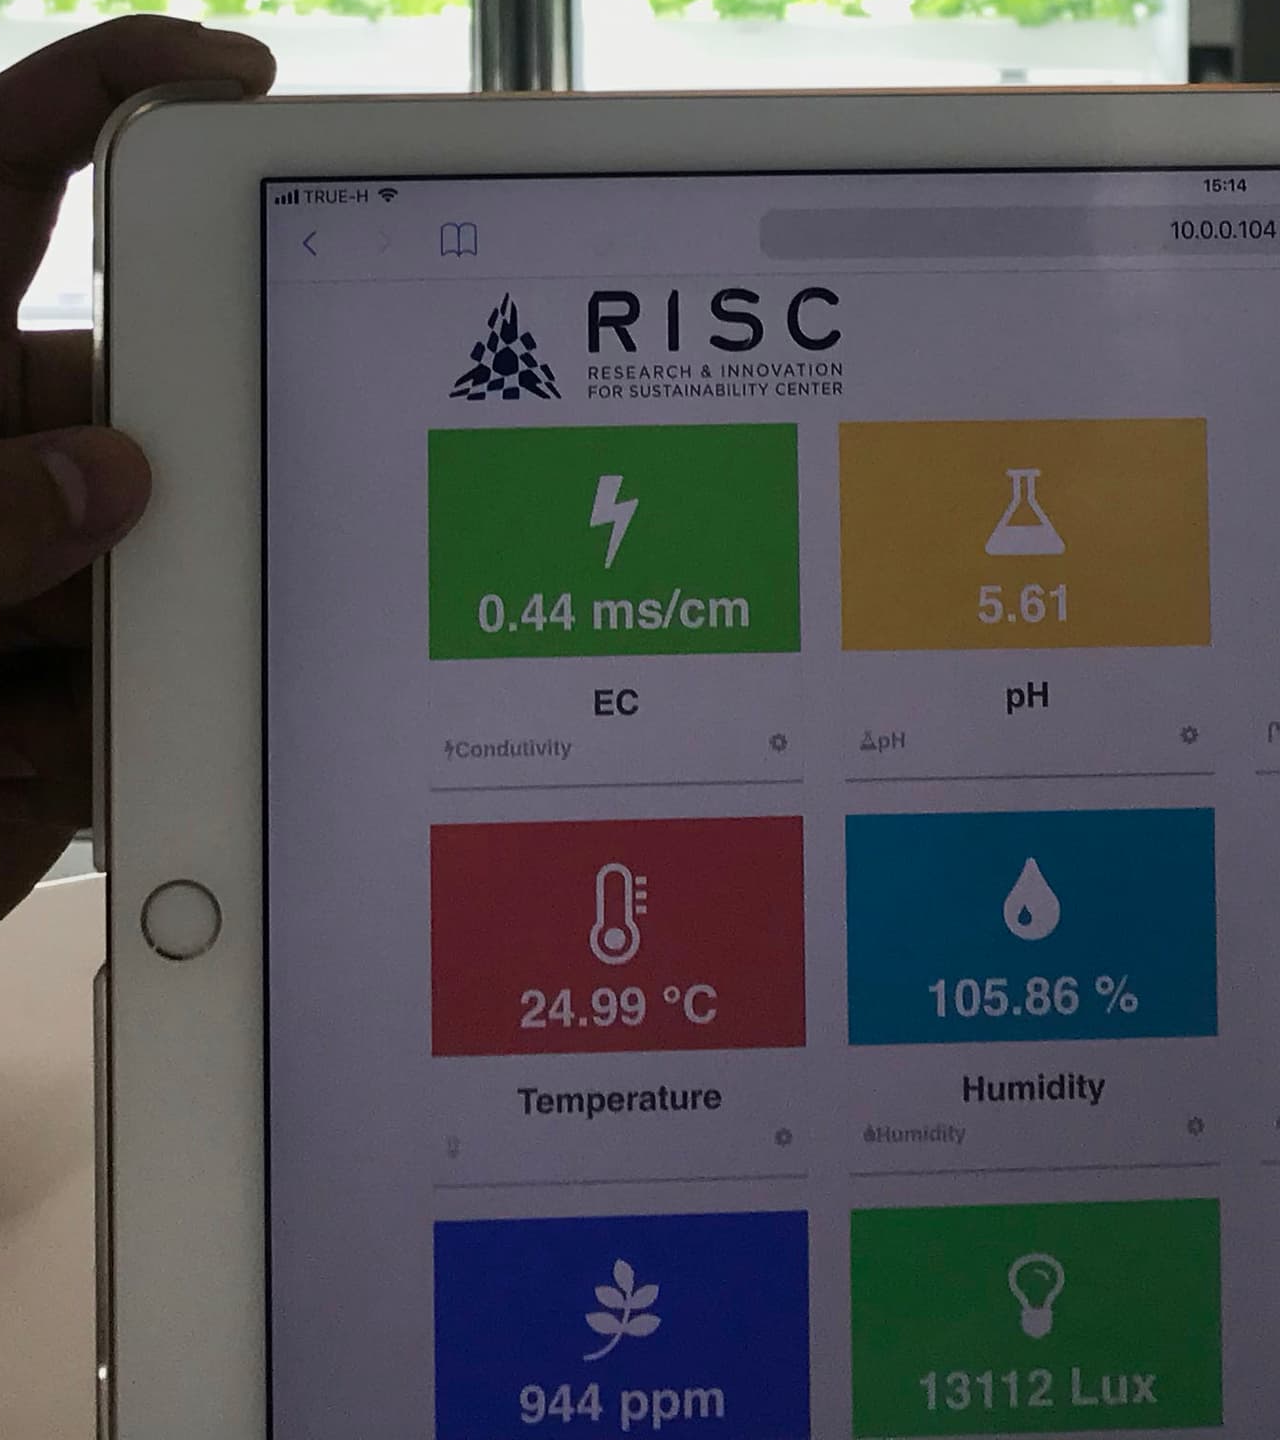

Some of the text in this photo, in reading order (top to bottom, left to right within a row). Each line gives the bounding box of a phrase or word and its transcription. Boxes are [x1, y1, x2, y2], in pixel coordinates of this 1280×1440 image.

[304, 189, 369, 204] TRUE-H
[1170, 219, 1277, 240] 10.0.0.104
[587, 287, 841, 353] RISC
[588, 362, 843, 380] RESEARCH & INNOVATION
[588, 381, 843, 400] FOR SUSTAINABILITY CENTER
[478, 588, 751, 633] 0.44 ms/cm
[977, 584, 1070, 624] 5.61
[593, 687, 640, 717] EC
[1005, 680, 1050, 714] pH
[455, 739, 572, 761] Condutivity
[877, 731, 906, 752] pH
[520, 984, 719, 1029] 24.99 °C
[927, 974, 1139, 1018] 105.86 %
[517, 1084, 722, 1118] Temperature
[963, 1072, 1107, 1109] Humidity
[876, 1123, 966, 1146] Humidity
[920, 1367, 1157, 1412] 13112 Lux
[520, 1384, 725, 1431] 944 ppm
